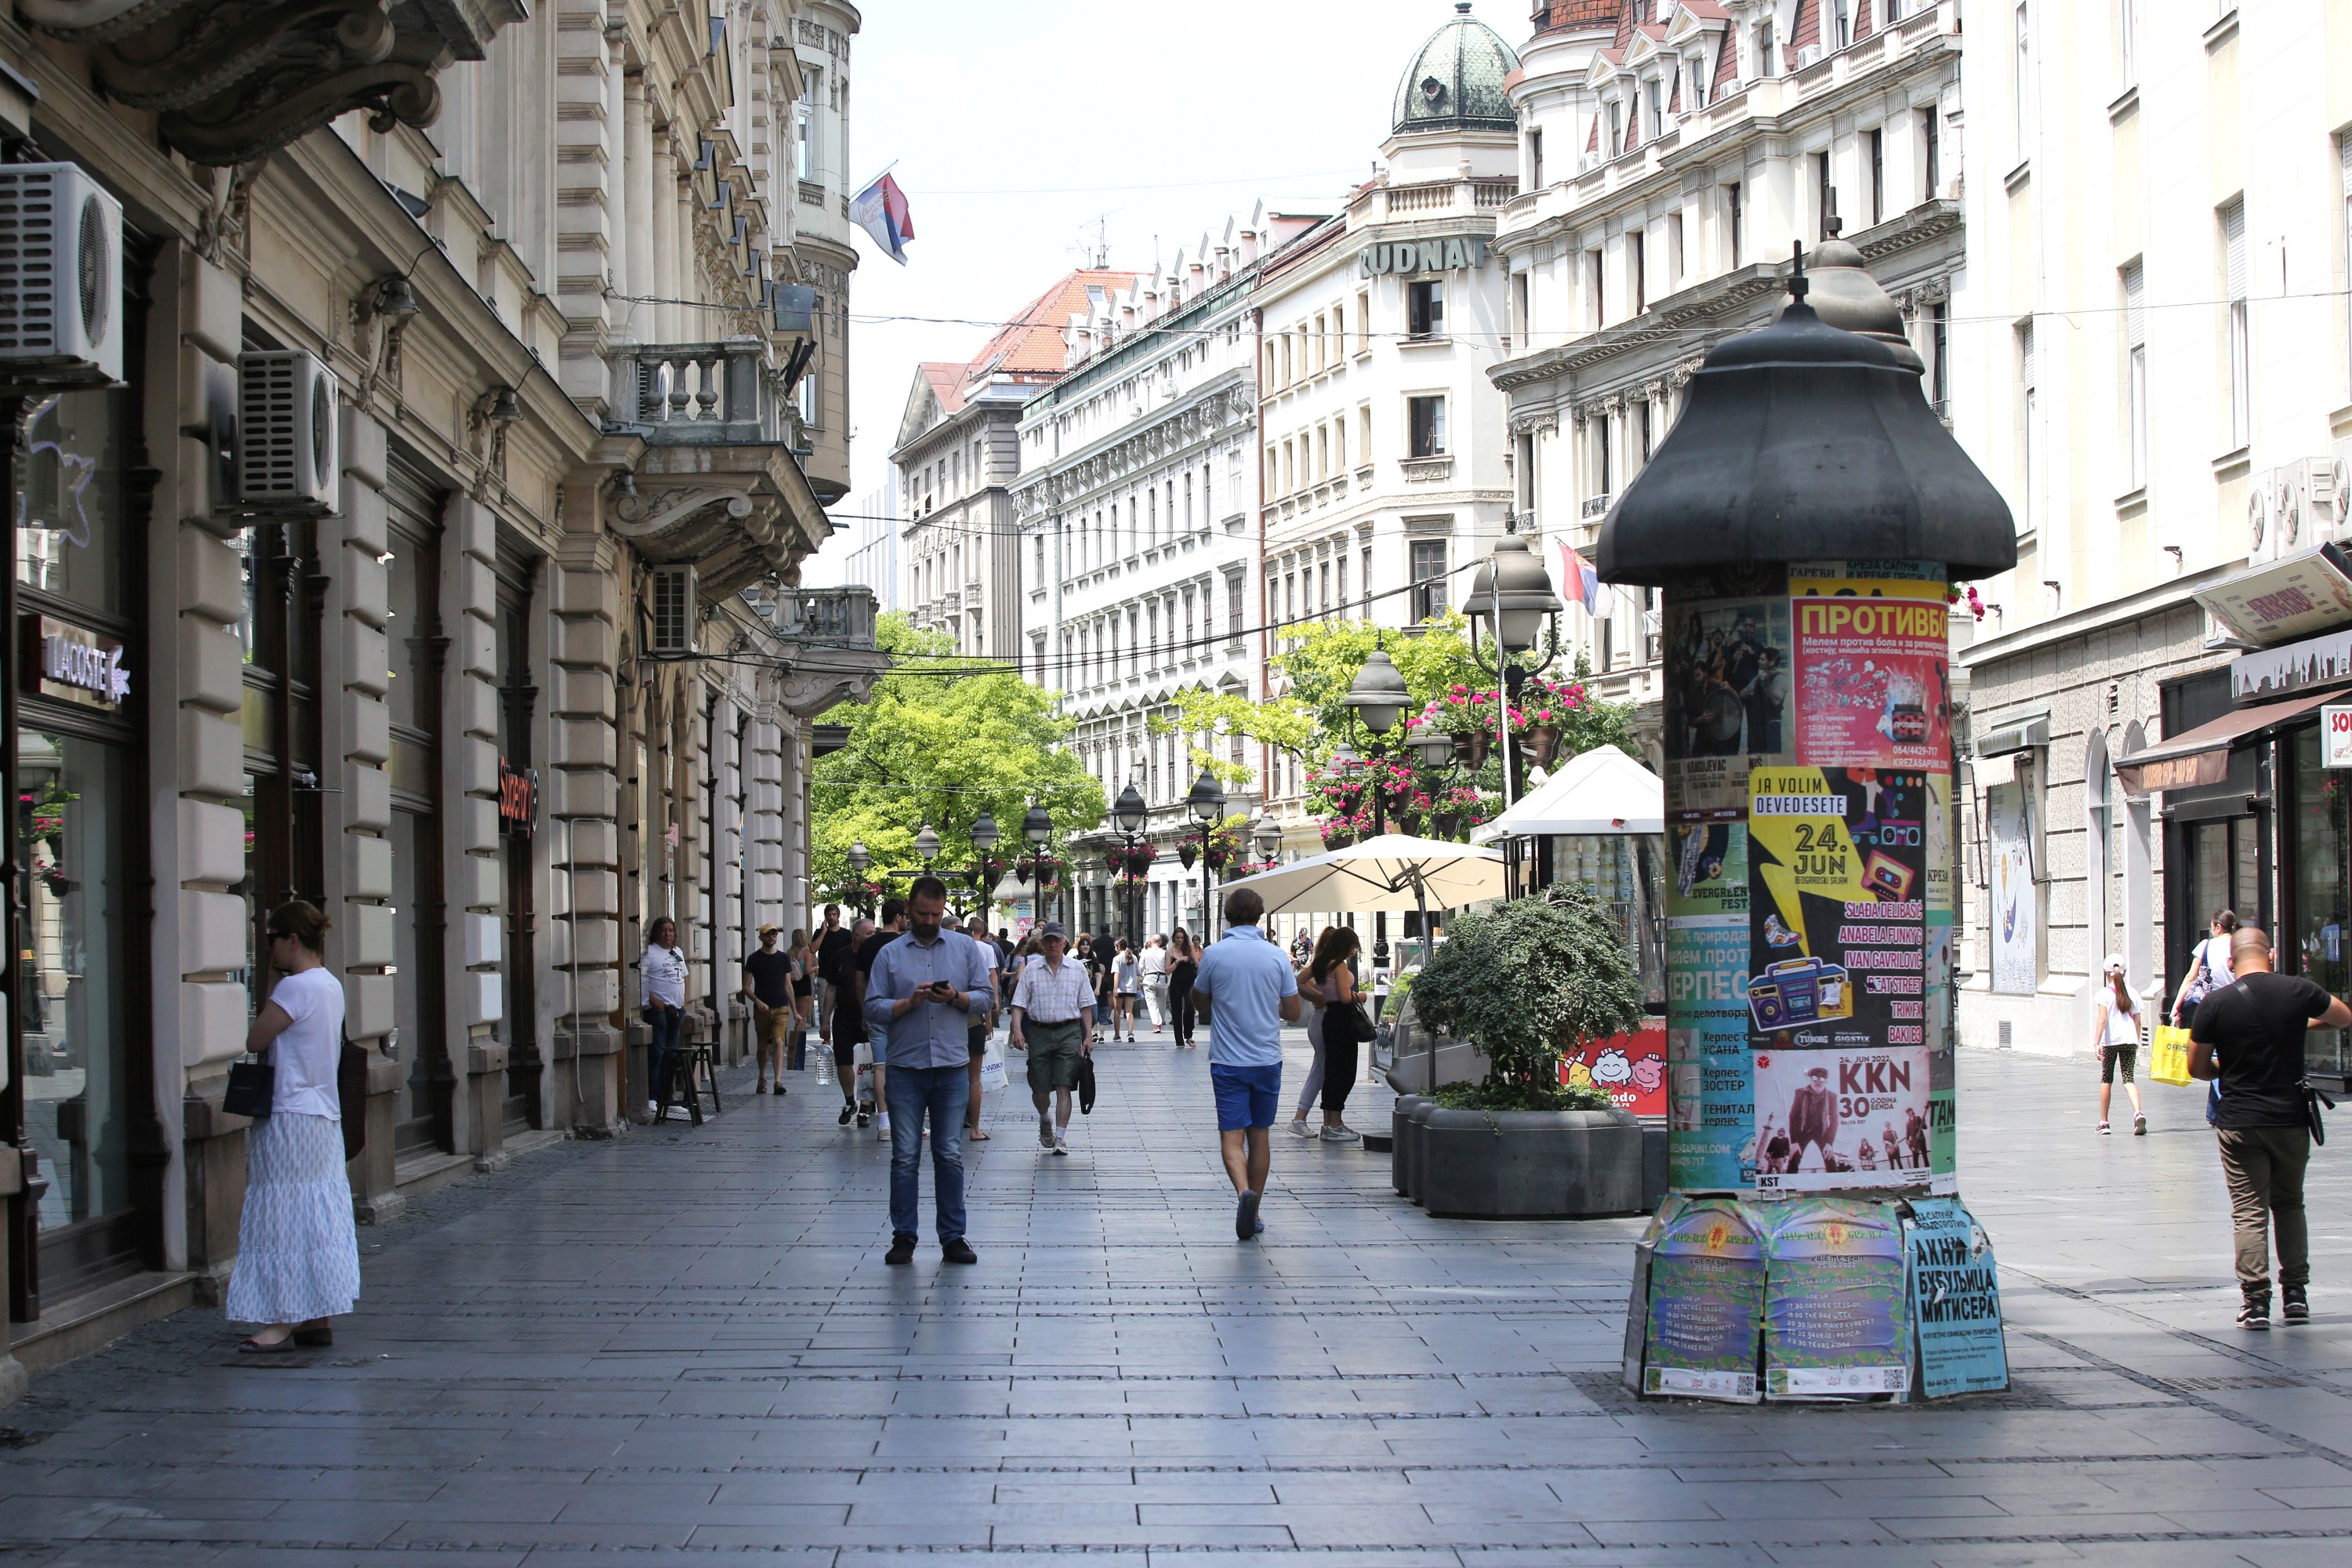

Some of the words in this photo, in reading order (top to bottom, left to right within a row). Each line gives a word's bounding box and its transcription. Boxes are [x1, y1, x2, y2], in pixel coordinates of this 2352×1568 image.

[1802, 637, 1838, 646] Мелем
[1840, 638, 1874, 649] против
[1876, 637, 1896, 647] бола
[47, 636, 107, 691] LACOSTE
[1756, 777, 1771, 793] JA
[1778, 777, 1823, 793] VOLIM
[1756, 797, 1843, 814] DEVEDESETE
[1795, 823, 1848, 852] 24.
[1794, 855, 1846, 875] JUN
[1692, 886, 1748, 900] EVERGREEN
[1721, 898, 1748, 910] FEST
[1845, 902, 1878, 920] SLAĐA
[1838, 926, 1886, 944] ANABELA
[1704, 947, 1749, 968] прот
[1845, 951, 1870, 968] IVAN
[1703, 1031, 1740, 1044] Херпес
[1888, 1025, 1910, 1044] BAKI
[1703, 1044, 1740, 1055] УСАНА
[1854, 1055, 1870, 1064] JUN
[1703, 1066, 1740, 1080] Херпес
[1839, 1061, 1911, 1094] KKN
[1703, 1080, 1745, 1091] ЗОСТЕР
[1838, 1097, 1870, 1118] 30
[1704, 1116, 1739, 1127] херпес
[1760, 1177, 1779, 1187] KST
[1915, 1236, 1966, 1266] АКНИ
[1921, 1296, 1996, 1323] МИТИСЕРА
